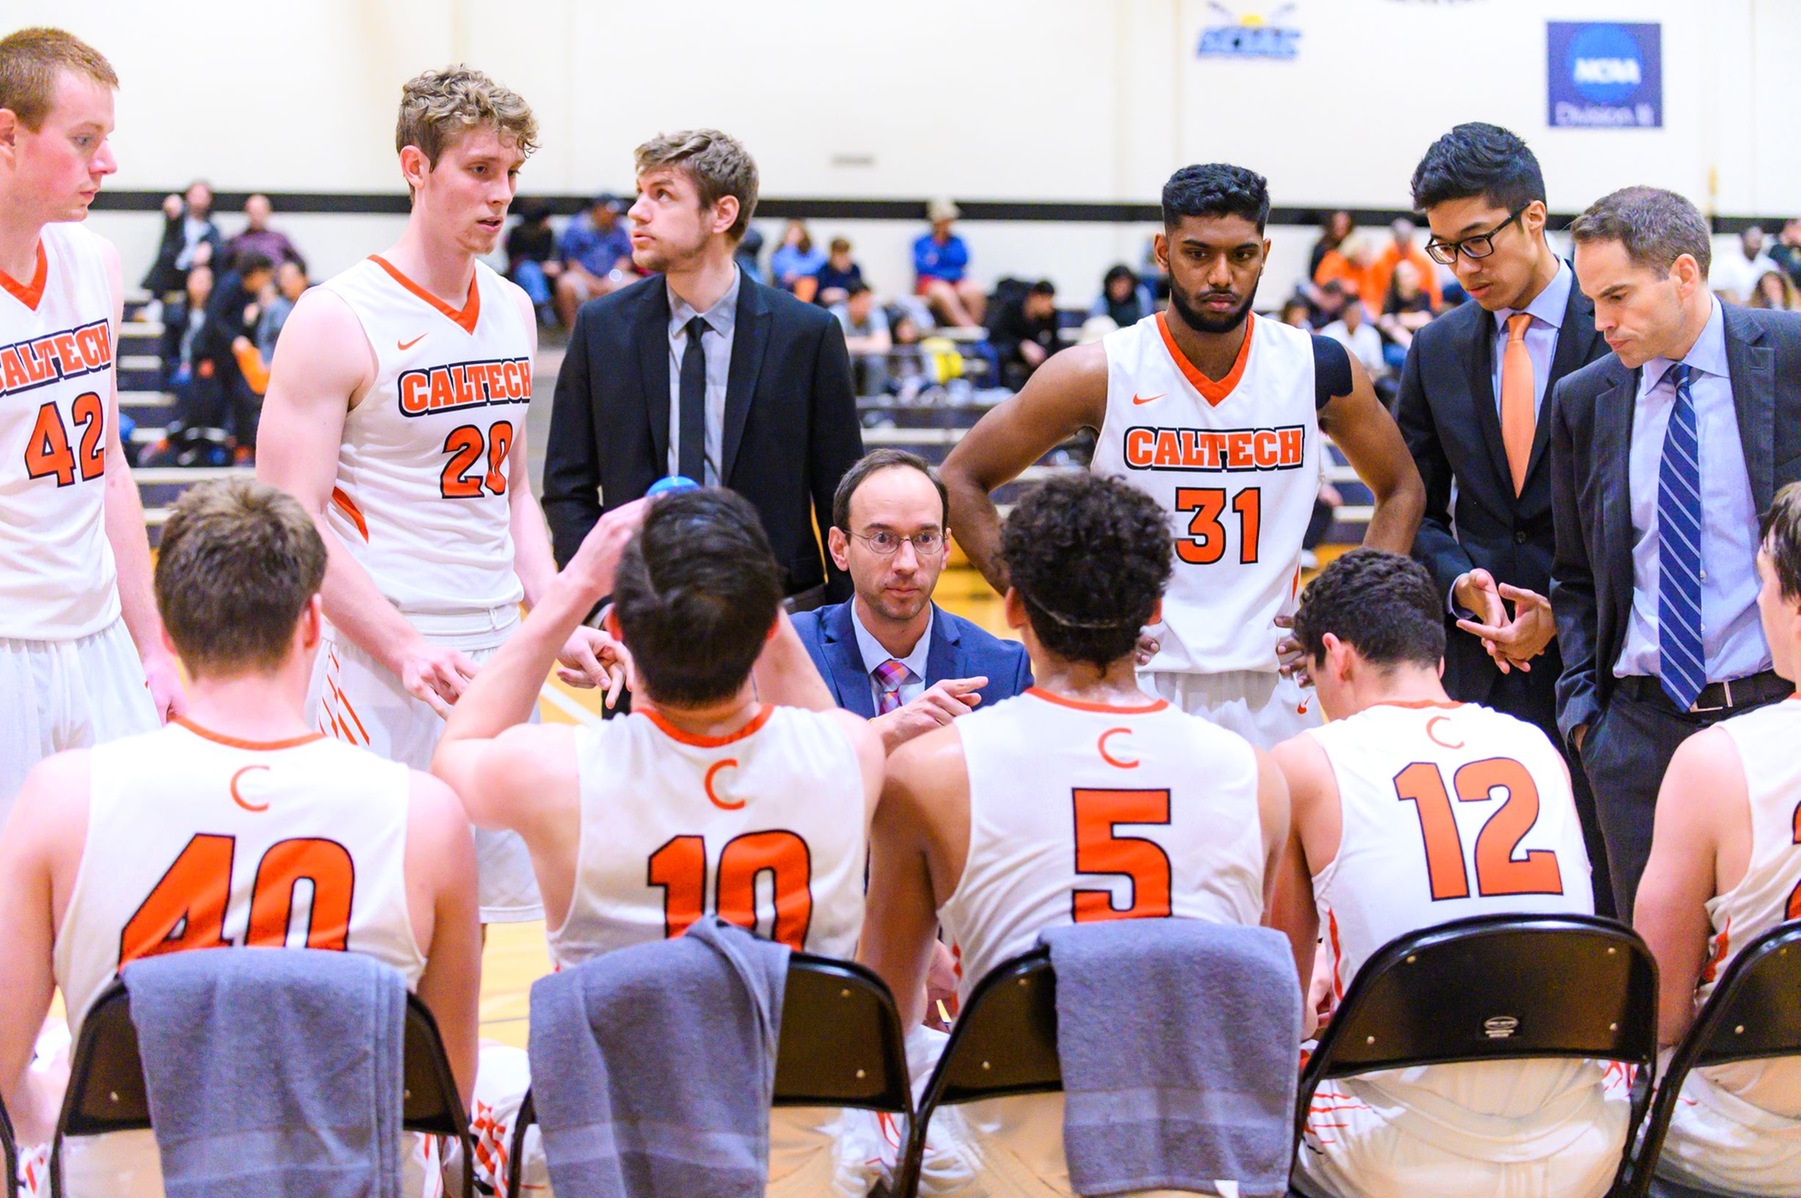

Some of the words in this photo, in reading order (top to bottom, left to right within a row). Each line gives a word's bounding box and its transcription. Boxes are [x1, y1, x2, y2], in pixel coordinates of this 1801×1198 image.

[0, 318, 112, 398] ALTECH
[398, 357, 532, 418] CALTECH
[24, 391, 105, 488] 42
[440, 420, 513, 499] 20
[1123, 424, 1305, 473] CALTECH
[1175, 486, 1261, 565] 31
[704, 758, 746, 811] C
[1097, 727, 1140, 769] C
[1071, 787, 1173, 924] 5
[1392, 756, 1564, 902] 12
[119, 832, 355, 964] 40
[647, 829, 813, 951] 10
